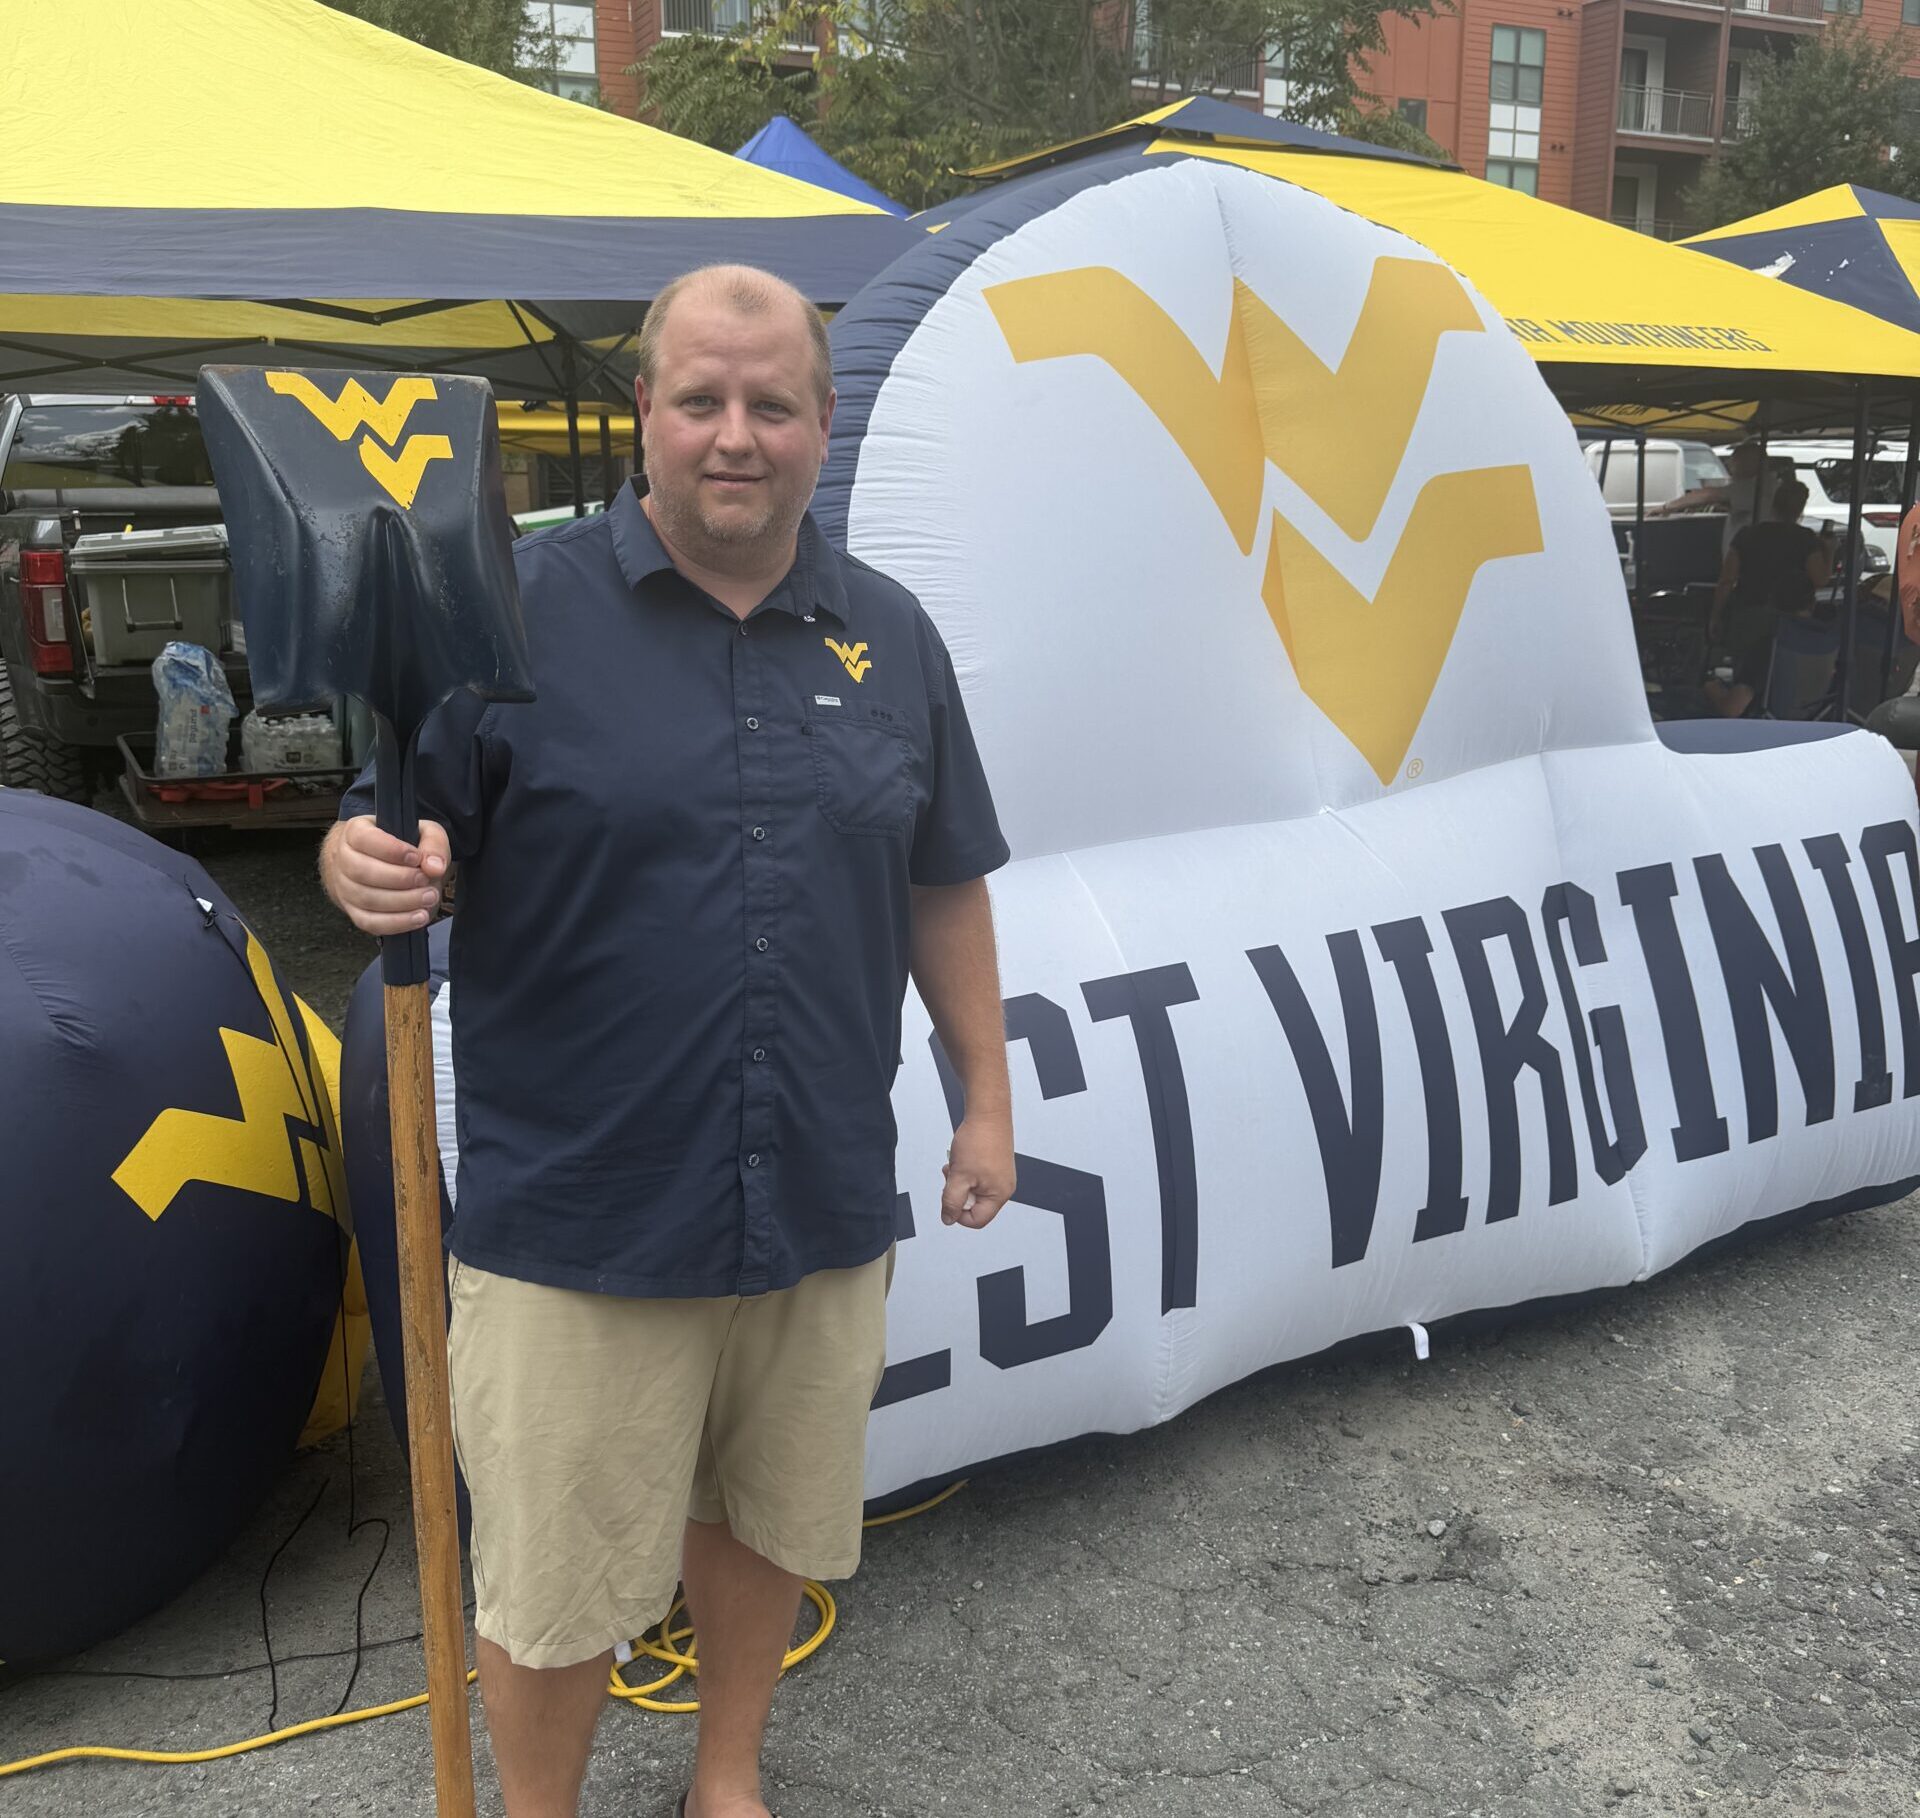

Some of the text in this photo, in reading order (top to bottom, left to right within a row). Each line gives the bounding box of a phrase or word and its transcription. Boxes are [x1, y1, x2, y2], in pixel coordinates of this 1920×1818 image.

[1545, 319, 1772, 352] MOUNTAINEERS
[265, 371, 454, 510] WV
[981, 255, 1545, 787] WV
[824, 637, 872, 683] WV
